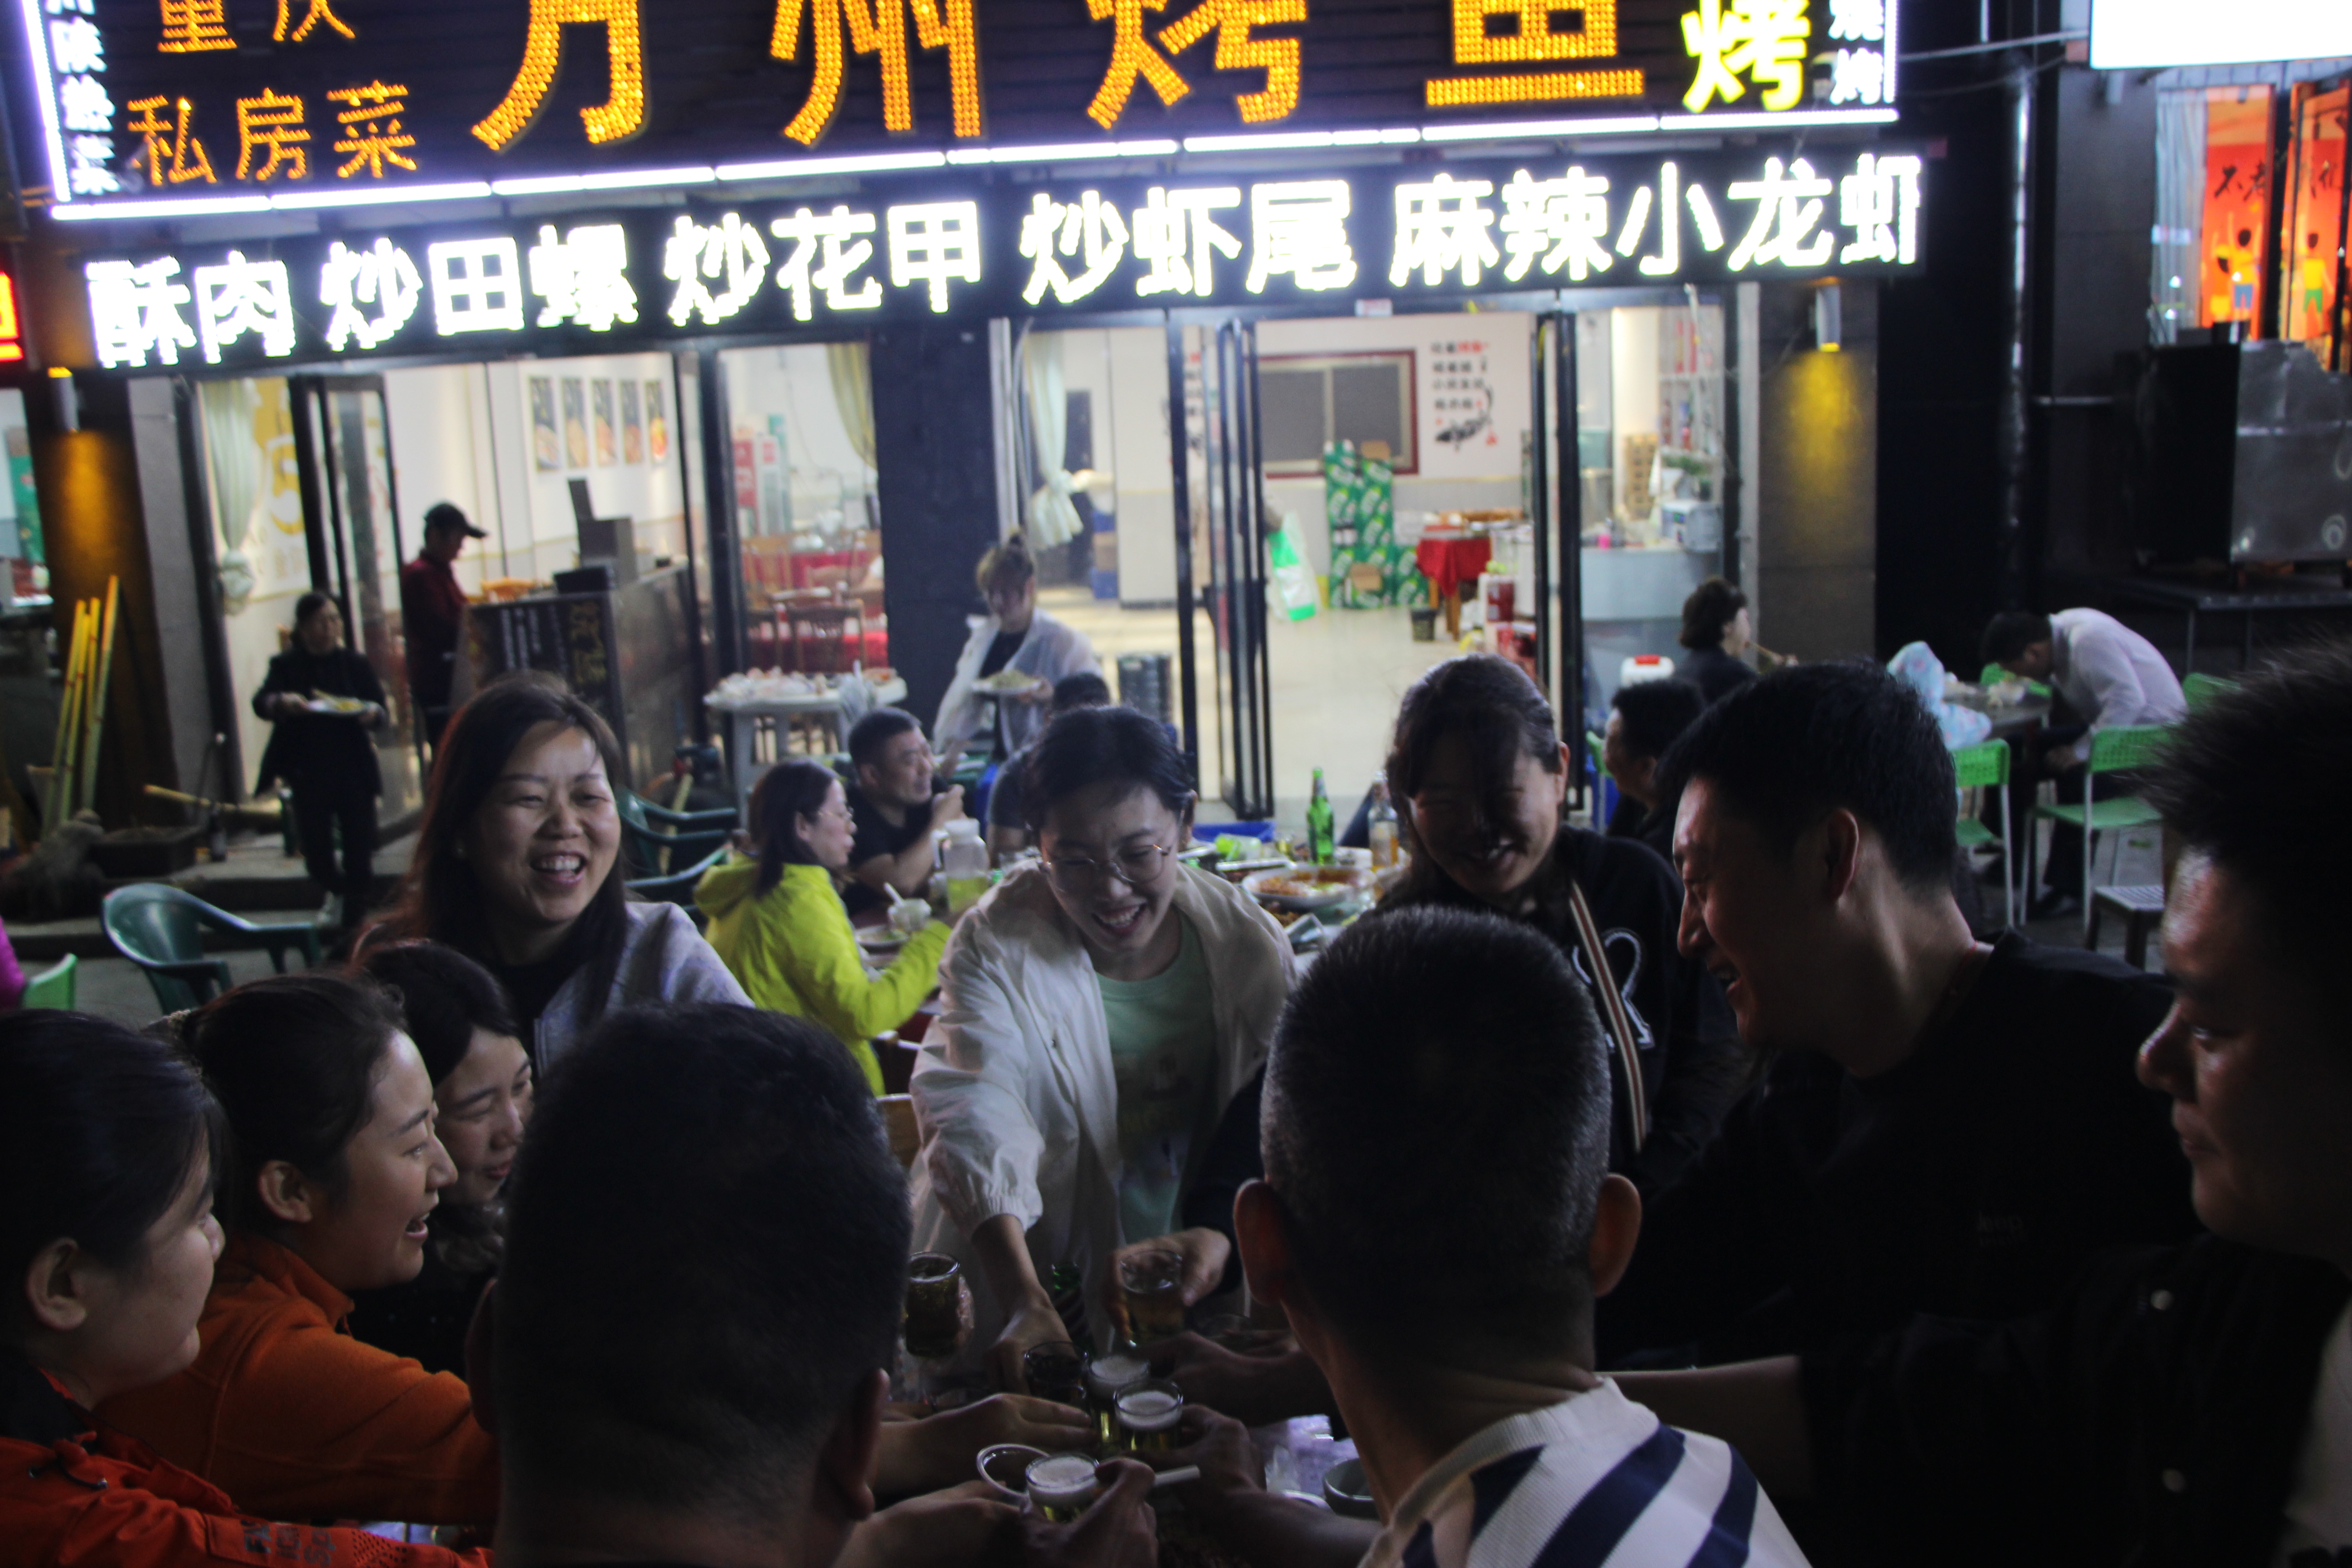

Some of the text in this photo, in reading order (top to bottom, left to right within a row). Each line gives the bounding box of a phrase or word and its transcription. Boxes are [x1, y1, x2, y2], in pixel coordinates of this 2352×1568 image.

[1681, 0, 1810, 113] 烤
[127, 80, 416, 186] 私房菜
[85, 250, 297, 369] 酥肉
[319, 224, 639, 352] 炒田螺
[664, 206, 981, 327] 炒花甲
[1019, 180, 1357, 305] 炒虾尾
[1388, 153, 1922, 287] 麻辣小龙虾
